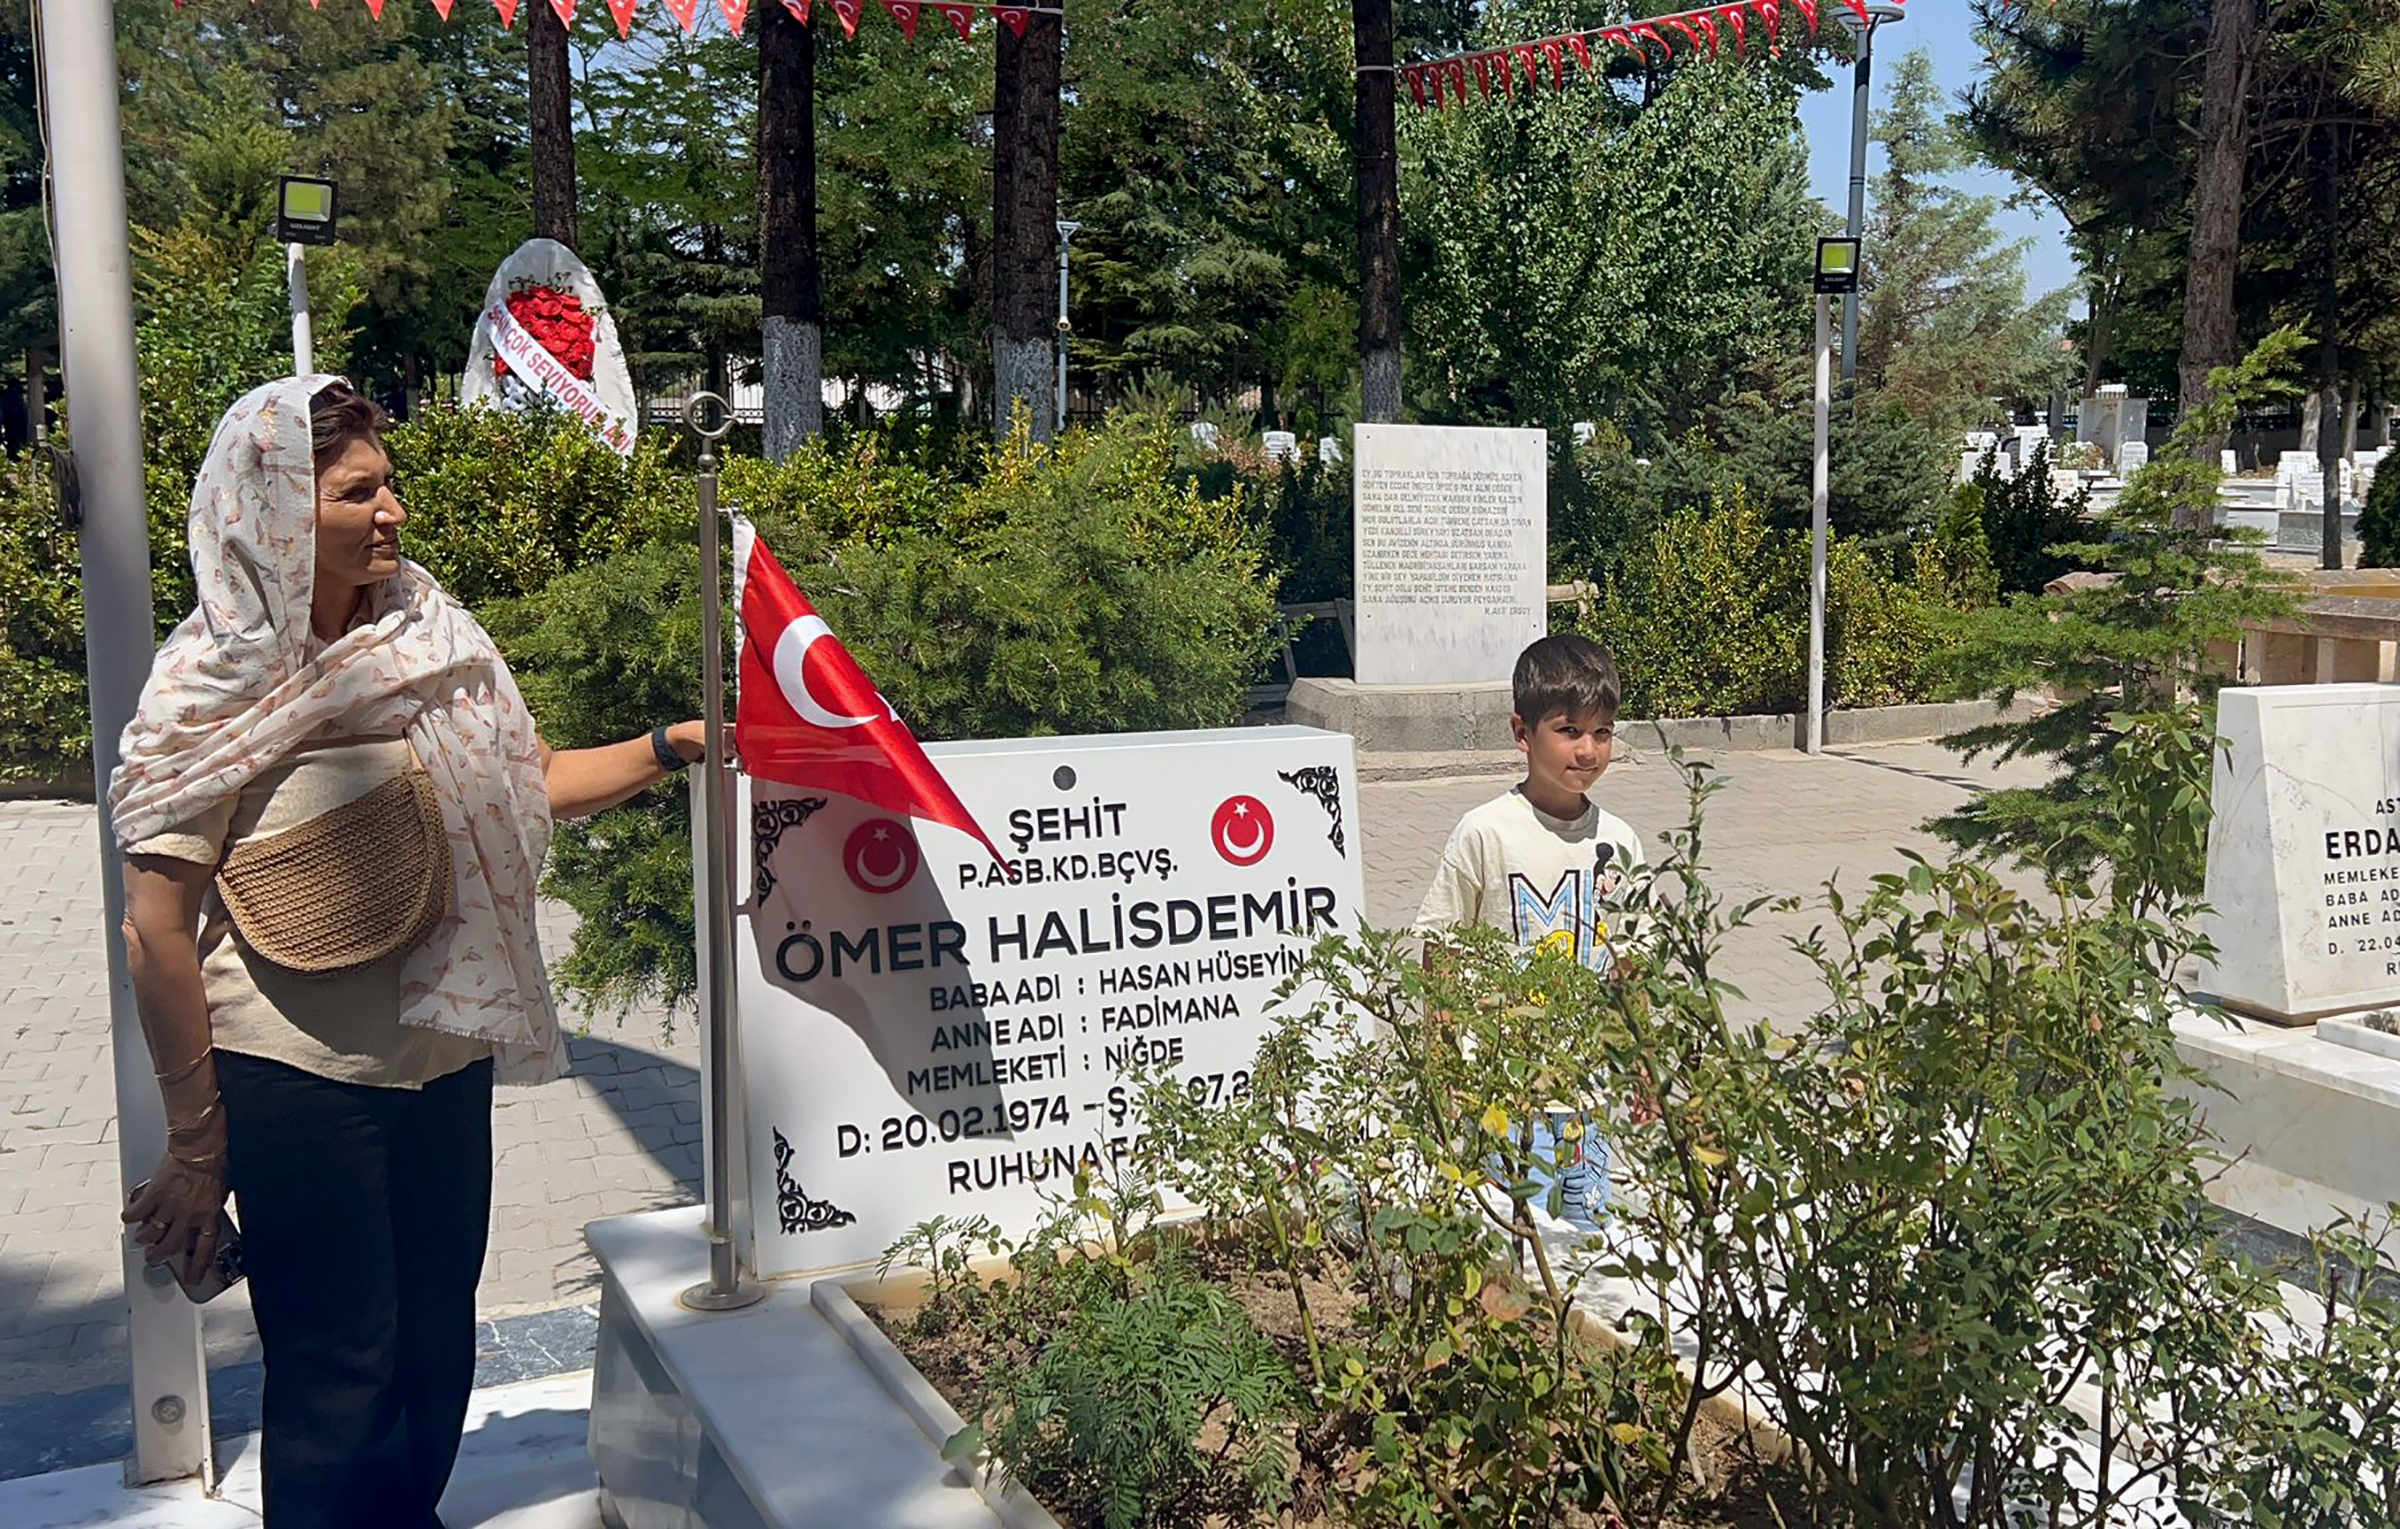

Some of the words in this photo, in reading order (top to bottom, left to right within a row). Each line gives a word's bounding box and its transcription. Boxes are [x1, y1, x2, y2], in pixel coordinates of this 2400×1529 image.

[526, 352, 603, 425] SEVİYORU
[1008, 796, 1127, 853] ŞEHİT
[2325, 828, 2400, 859] ERDA
[959, 848, 1178, 889] P.ASB.KD.BÇVŞ.
[2324, 867, 2400, 885] MEMLEKE
[2325, 891, 2369, 907] BABA
[2381, 888, 2400, 902] AD
[2328, 912, 2371, 928] ANNE
[776, 920, 970, 982] ÖMER
[989, 876, 1338, 963] HALİSDEMİR
[2328, 942, 2345, 955] D.
[930, 980, 1010, 1012] BABA
[1014, 974, 1061, 1005] ADI
[1099, 960, 1190, 995] HASAN
[1197, 943, 1304, 983] HÜSEYİN
[931, 1018, 1011, 1051] ANNE
[1017, 1013, 1063, 1044] ADI
[1102, 993, 1240, 1033] FADİMANA
[908, 1044, 1066, 1096] MEMLEKETİ
[1104, 1036, 1183, 1071] NİĞDE
[837, 1124, 870, 1158] D:
[881, 1095, 1070, 1151] 20.02.1974
[948, 1142, 1104, 1195] RUHUNA
